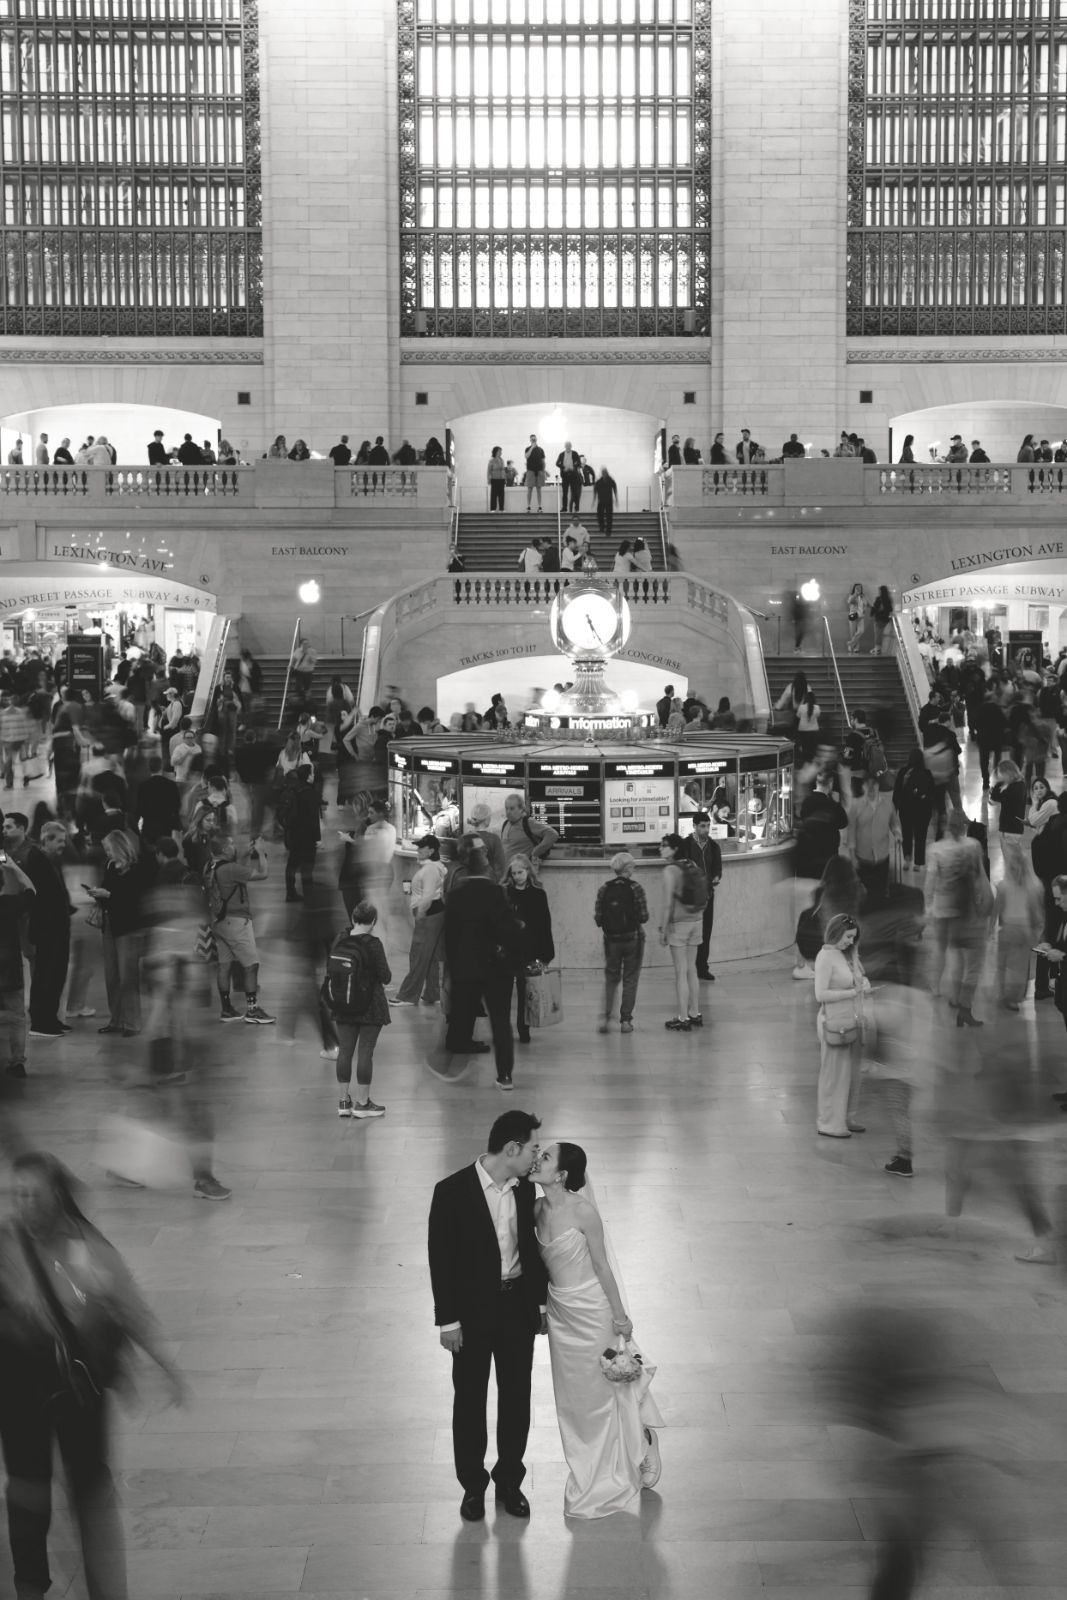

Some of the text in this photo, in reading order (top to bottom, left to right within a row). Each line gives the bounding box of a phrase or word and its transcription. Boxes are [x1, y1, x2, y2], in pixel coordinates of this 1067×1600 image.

[54, 545, 168, 572] LEXINGTON AVE
[271, 546, 349, 556] EAST BALCONY
[770, 545, 848, 555] EAST BALCONY
[951, 542, 1064, 571] LEXINGTON AVE
[19, 591, 61, 605] STREET
[64, 588, 113, 600] PASSAGE
[123, 589, 170, 601] SUBWAY
[914, 588, 956, 602] STREET
[960, 585, 1009, 596] PASSAGE
[1015, 585, 1065, 598] SUBWAY
[459, 644, 537, 666] TRACKS 100 TO 117
[627, 649, 682, 671] CONCOURSE
[569, 716, 631, 729] Information
[548, 787, 582, 795] ARRIVALS
